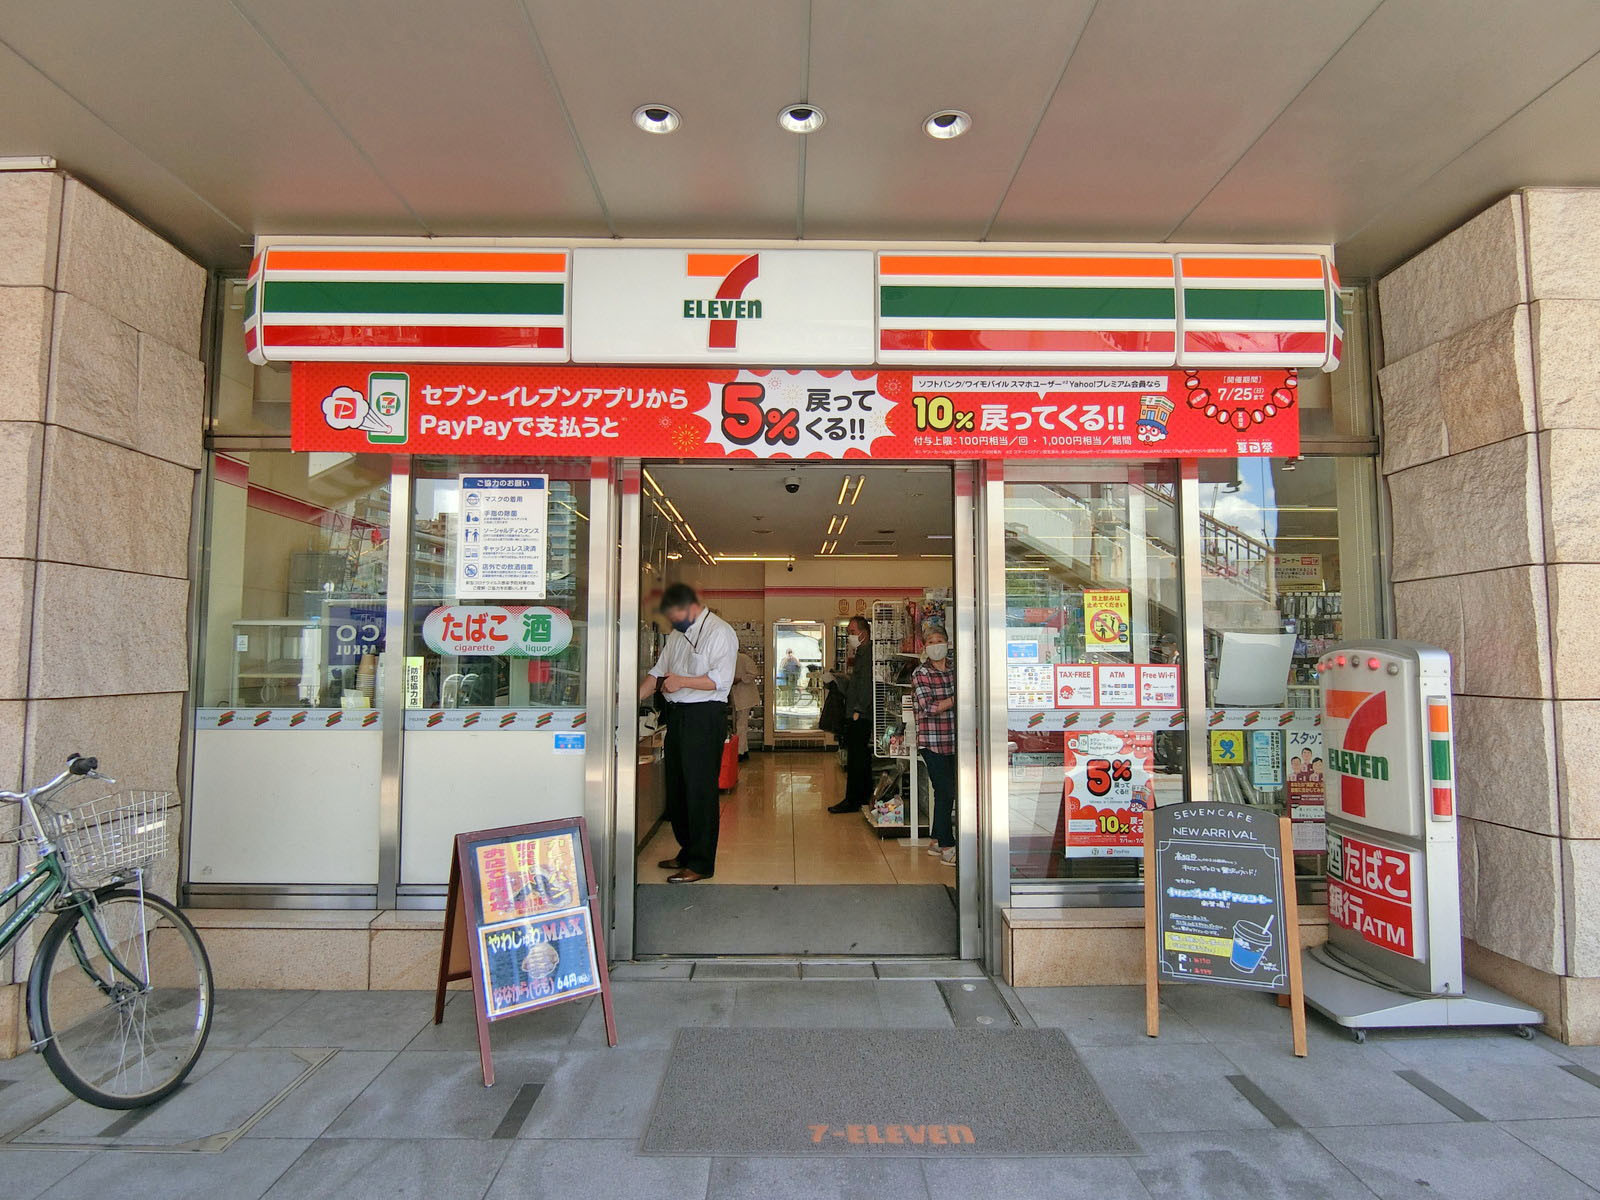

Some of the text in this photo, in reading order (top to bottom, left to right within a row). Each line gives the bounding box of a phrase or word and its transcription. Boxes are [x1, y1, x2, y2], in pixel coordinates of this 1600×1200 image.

[688, 254, 759, 348] 7
[1069, 380, 1160, 389] Yahoo!プレミアム会員なら
[1217, 387, 1252, 401] 7/25
[805, 388, 876, 412] 戻って
[721, 382, 799, 446] 5%
[912, 395, 975, 432] 10%
[980, 404, 1125, 431] 戻ってくる!!
[420, 415, 619, 440] PayPayで支払うと
[805, 416, 865, 441] くる!!
[476, 479, 530, 487] ご協力のお願い
[442, 612, 508, 642] たばこ
[522, 613, 553, 643] 酒
[454, 644, 495, 652] cigarette
[525, 644, 552, 652] liquor
[410, 667, 419, 705] 防犯協力店
[1142, 671, 1176, 679] Free Wi-Fi
[1290, 732, 1322, 745] スタッ
[1326, 688, 1388, 818] 7
[1086, 758, 1132, 797] 5%
[1099, 815, 1130, 834] 10%
[1172, 826, 1258, 841] NEW ARRIVAL
[1345, 842, 1408, 897] たばこ
[542, 918, 583, 942] MAX
